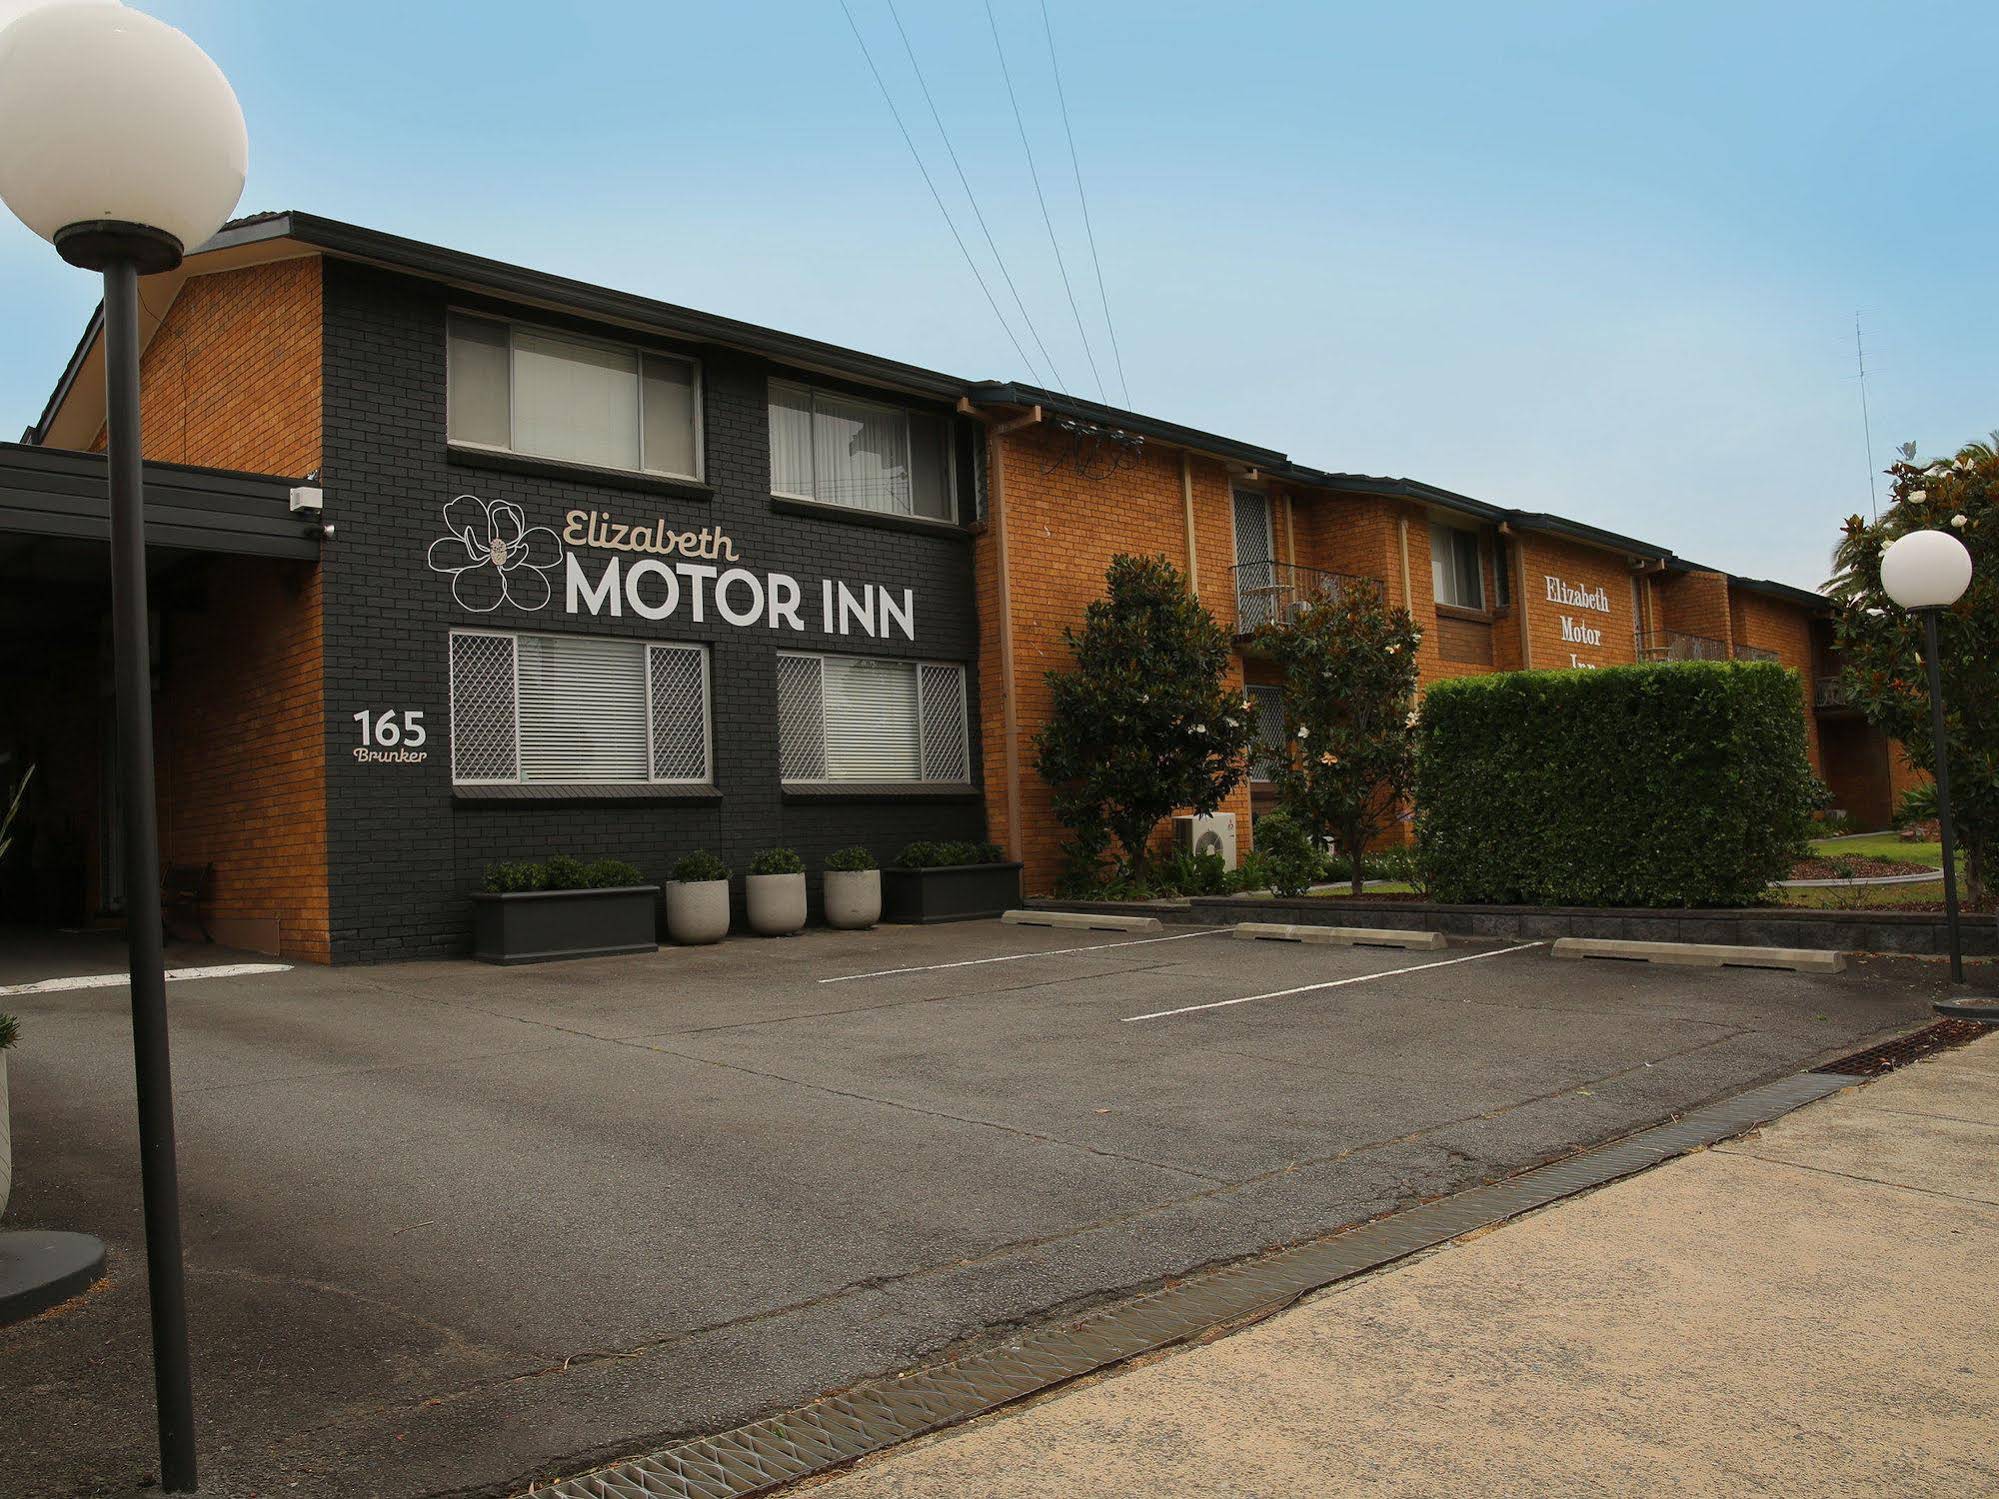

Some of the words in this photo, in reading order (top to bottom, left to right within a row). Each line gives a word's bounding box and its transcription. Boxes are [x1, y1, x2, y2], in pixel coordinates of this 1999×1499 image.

[563, 510, 739, 561] Elizabeth
[566, 552, 804, 631] MOTOR
[823, 579, 914, 641] INN
[1544, 575, 1610, 613] Elizabeth
[1560, 615, 1601, 646] Motor
[353, 709, 426, 747] 165
[353, 747, 427, 762] Brunker
